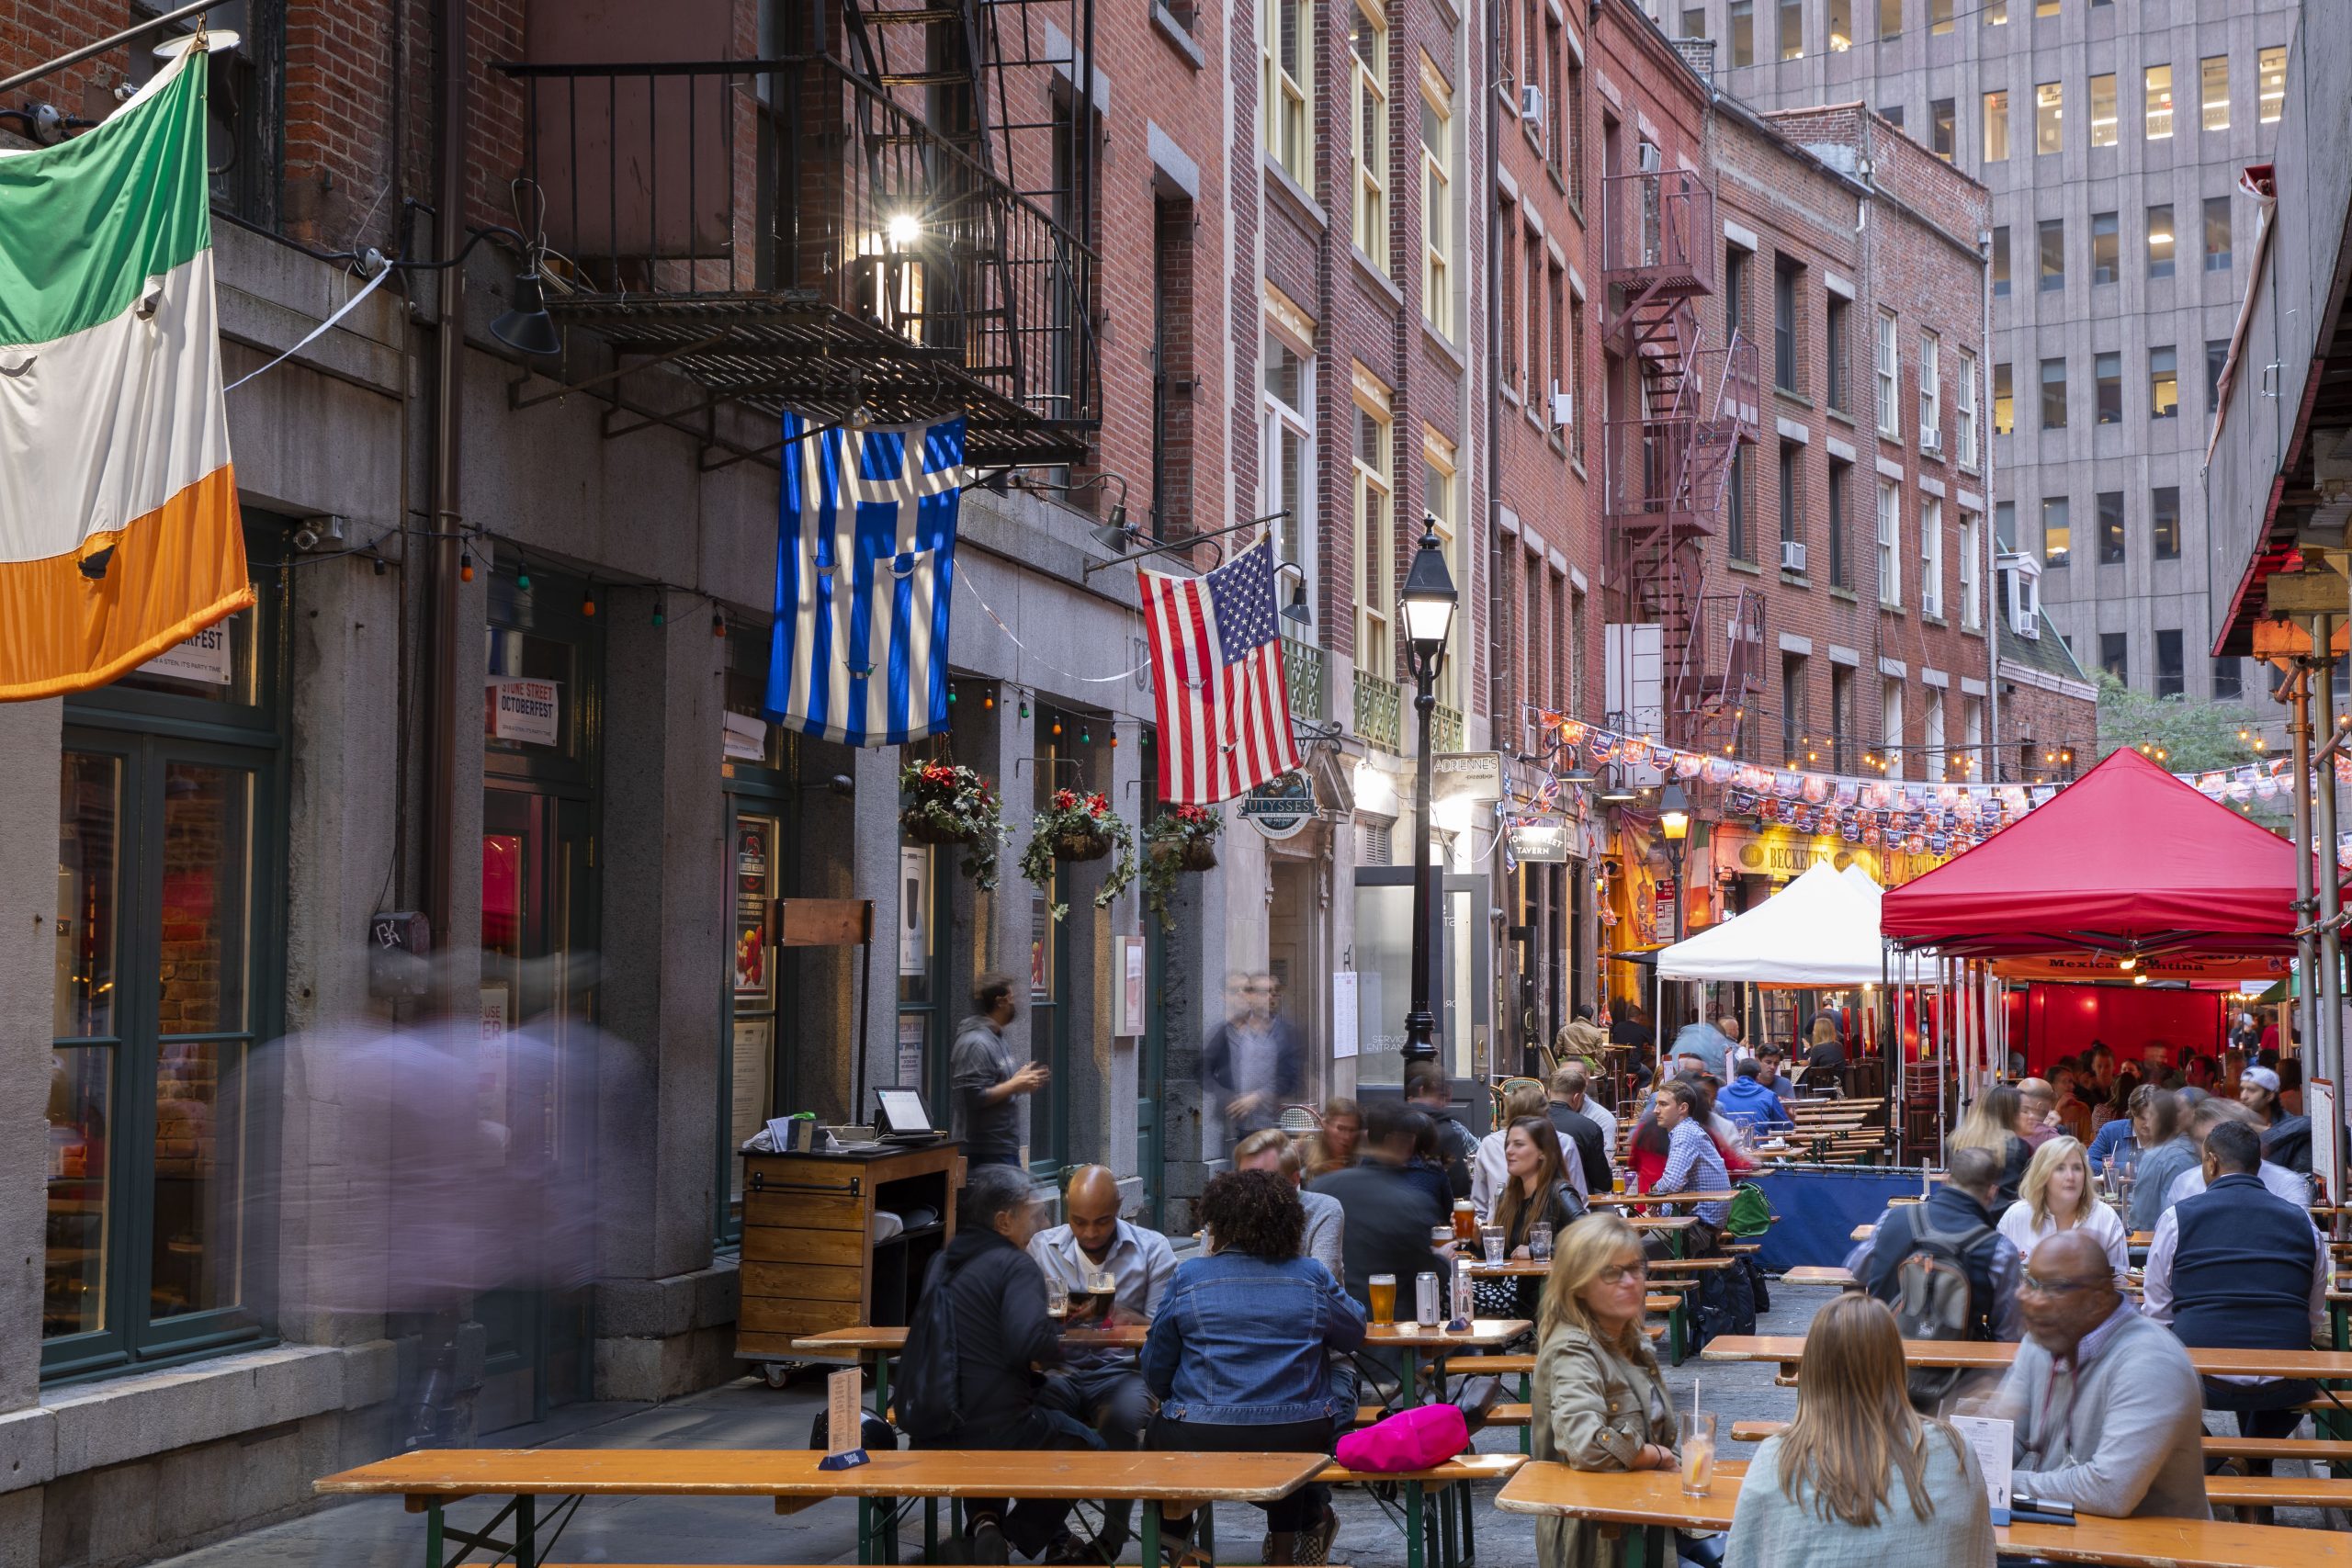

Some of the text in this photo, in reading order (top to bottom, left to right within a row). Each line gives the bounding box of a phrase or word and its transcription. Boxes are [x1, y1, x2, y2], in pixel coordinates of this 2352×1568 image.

[526, 682, 553, 701] STREET
[502, 695, 553, 718] OCTOBERFEST
[1434, 758, 1498, 773] ADRIENNE'S
[1516, 846, 1549, 855] TAVERN
[1770, 847, 1828, 870] BECKETT'S
[2049, 958, 2204, 971] Mexica ntina
[1372, 1034, 1408, 1043] SERVICE
[1366, 1043, 1406, 1052] ENTRAN
